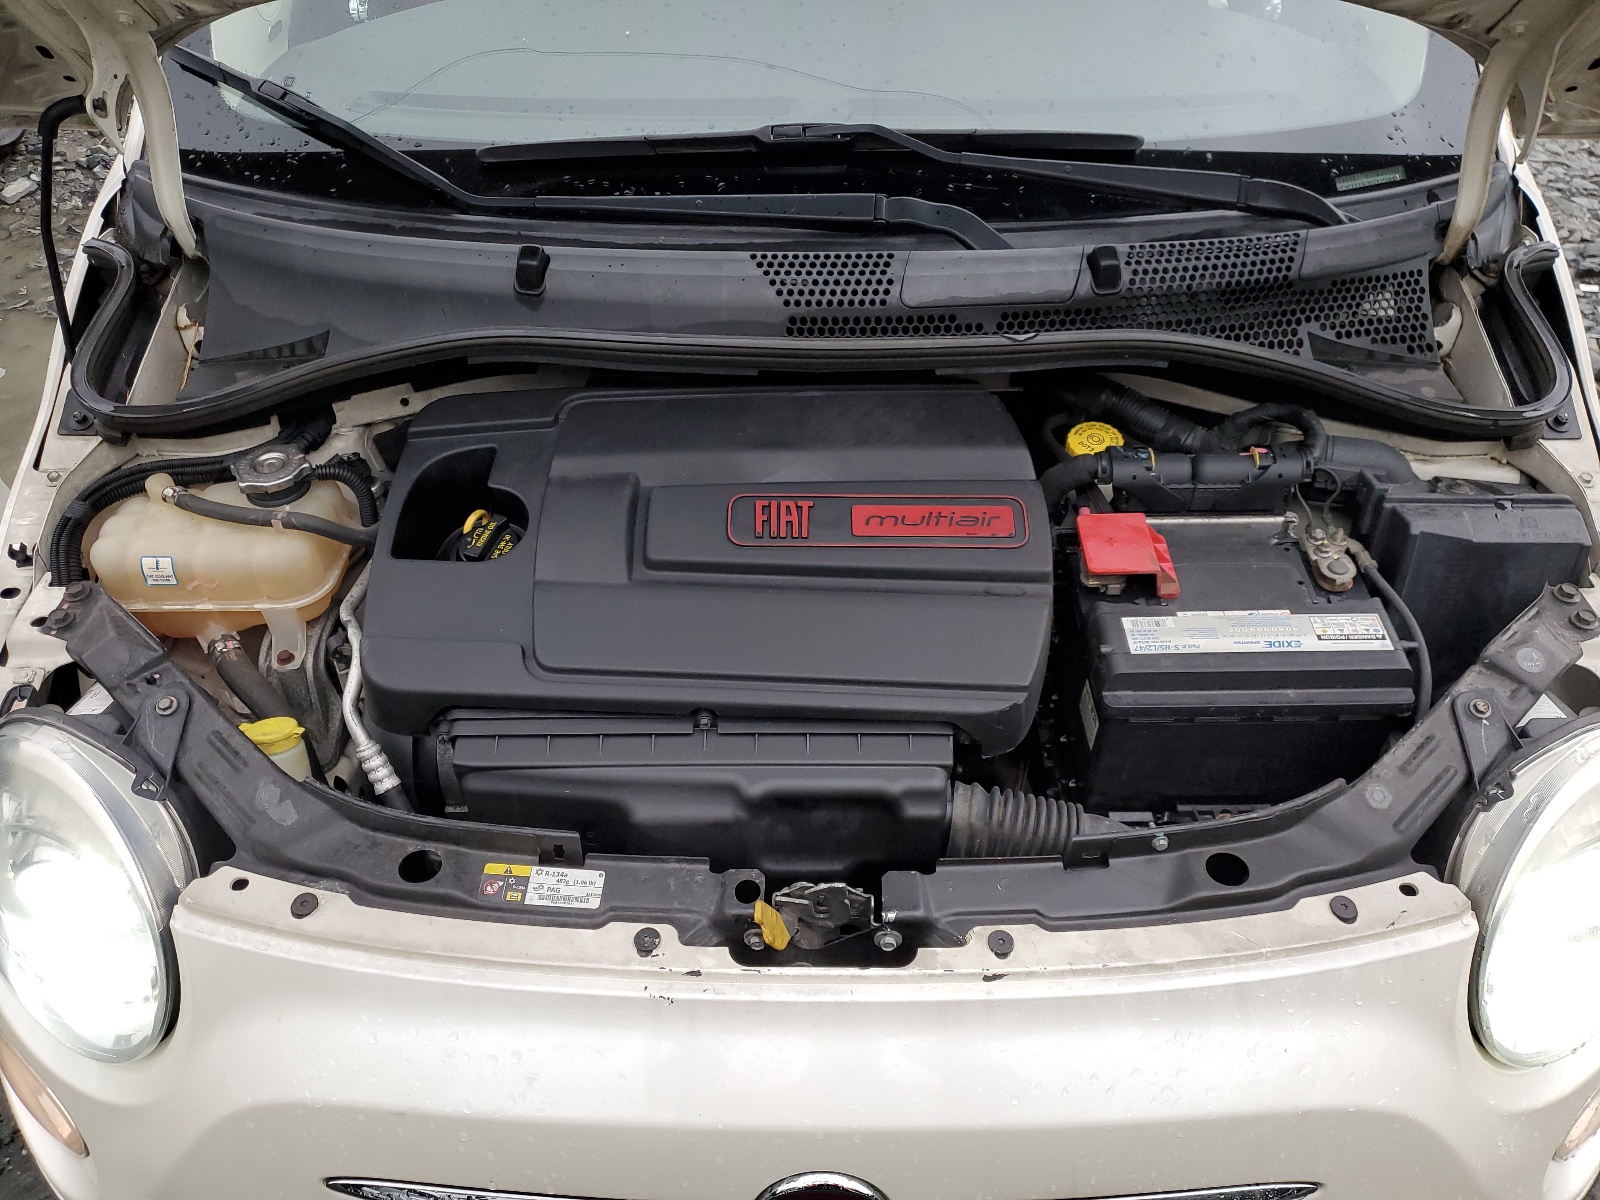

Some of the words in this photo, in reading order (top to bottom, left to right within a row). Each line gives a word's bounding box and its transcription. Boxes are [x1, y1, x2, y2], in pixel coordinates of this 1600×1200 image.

[754, 500, 814, 538] FIAT
[864, 511, 1001, 528] multiair
[1264, 640, 1302, 648] EXIDE
[545, 870, 569, 878] R-134a
